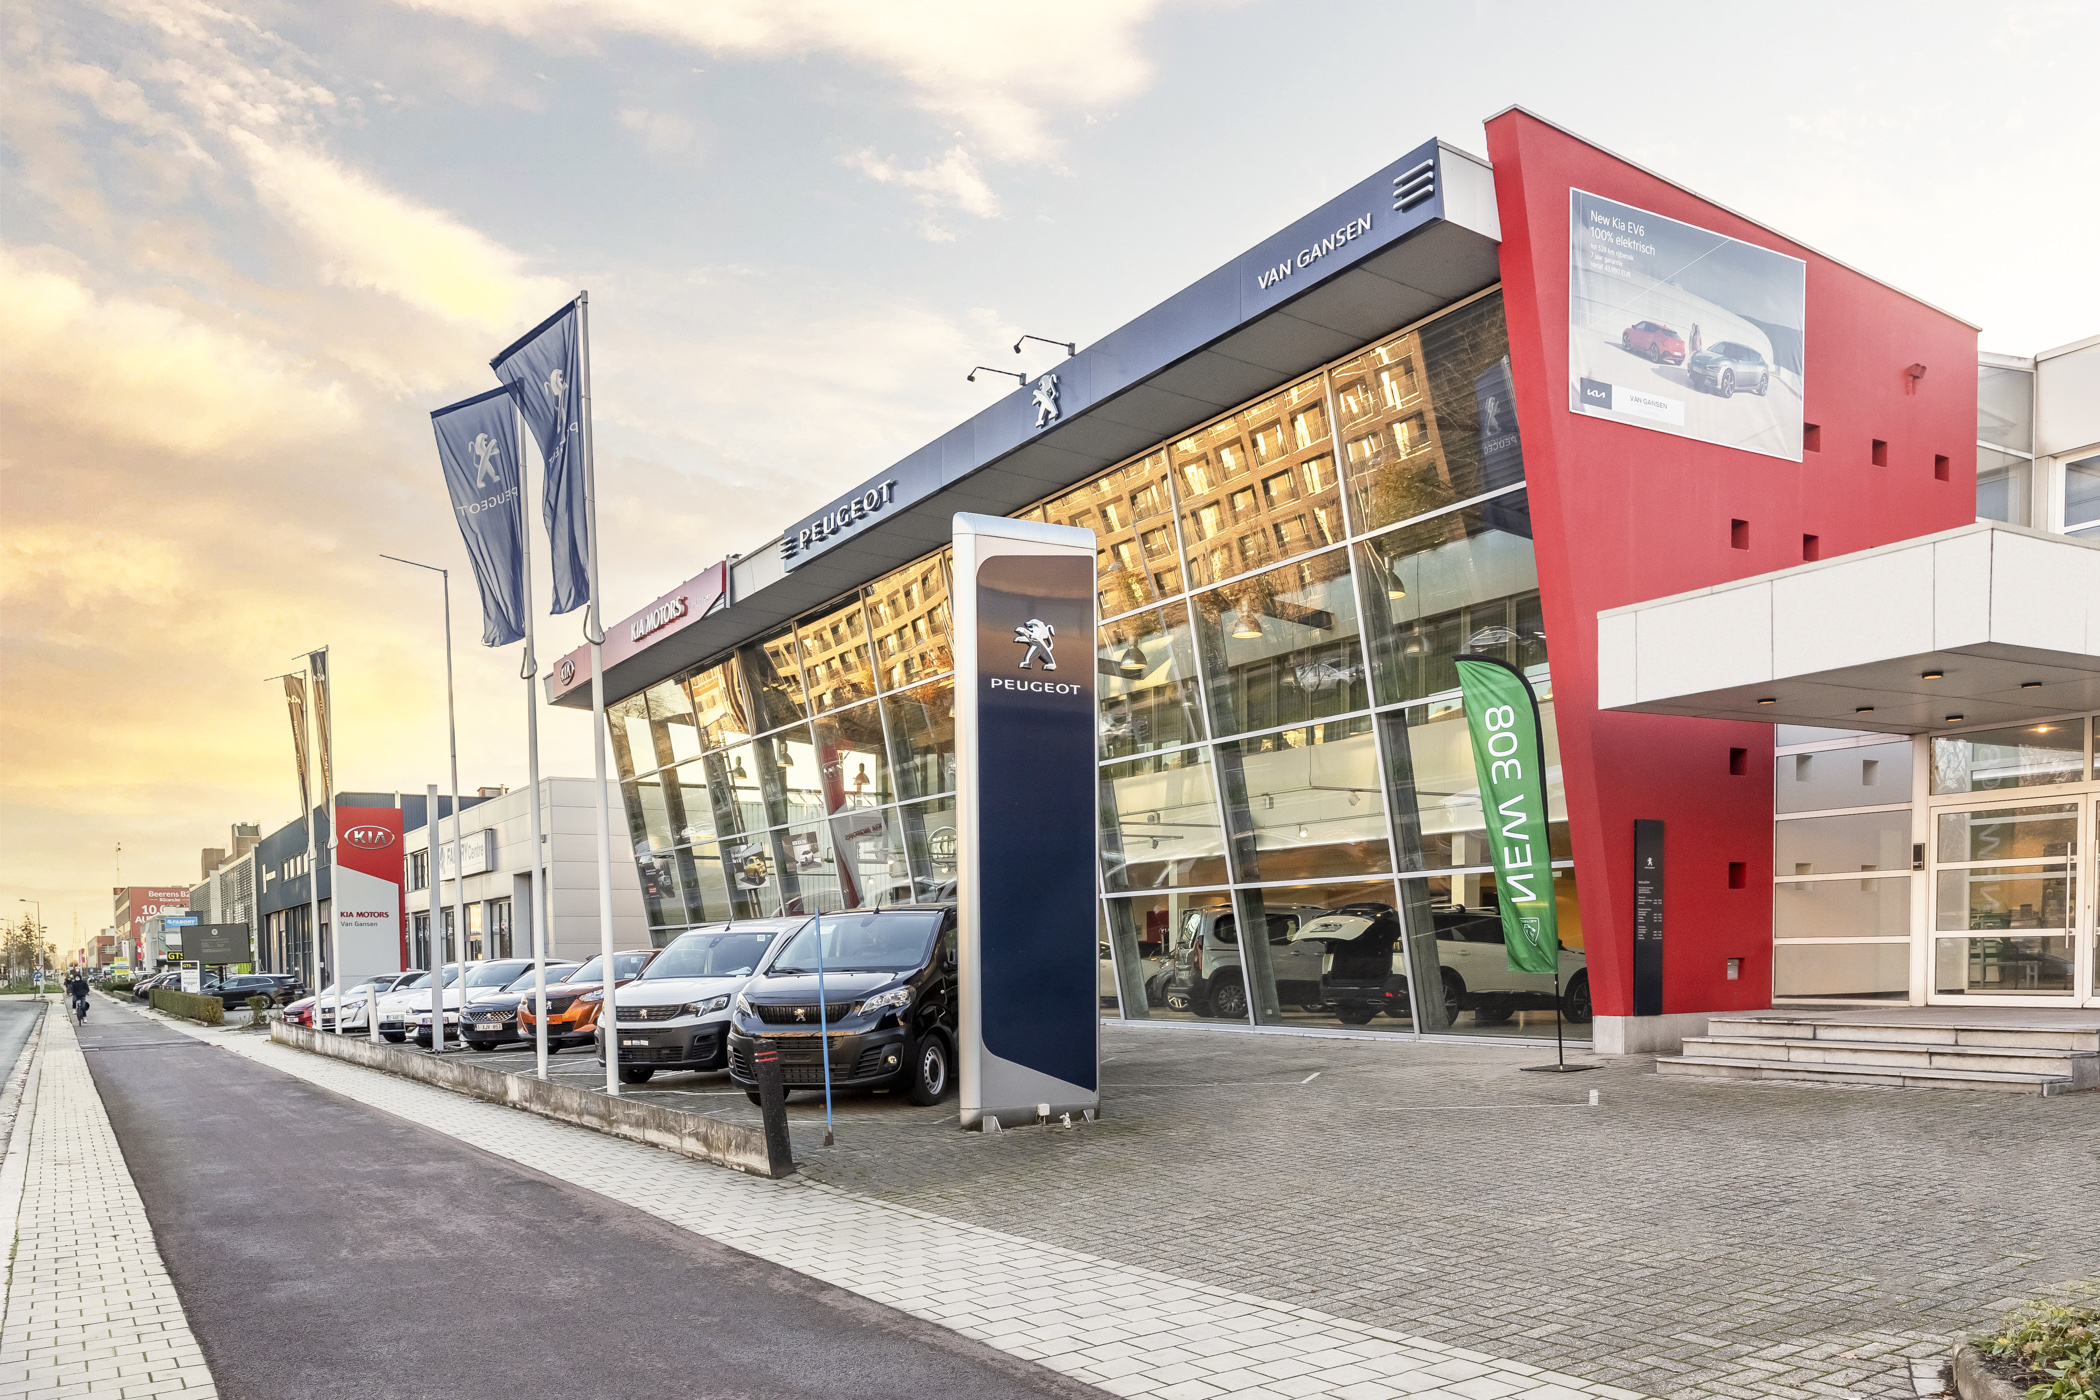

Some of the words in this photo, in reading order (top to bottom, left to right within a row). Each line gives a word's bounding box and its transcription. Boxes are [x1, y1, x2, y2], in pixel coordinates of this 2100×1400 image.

[1590, 209, 1610, 226] New
[1612, 217, 1625, 231] Kia
[1627, 221, 1645, 237] EV6
[1257, 259, 1292, 290] VAN
[1296, 212, 1373, 269] GANSEN
[1590, 226, 1614, 244] 100%
[1615, 235, 1656, 256] elektrisch
[1629, 395, 1642, 404] VAN
[1642, 398, 1668, 410] GANSEN
[799, 479, 897, 549] PEUGEOT
[630, 617, 645, 641] KIA
[644, 596, 687, 635] MOTORS
[991, 678, 1081, 695] PEUGEOT
[353, 830, 387, 844] KIA
[148, 890, 180, 898] Beerens
[356, 911, 390, 919] MOTORS
